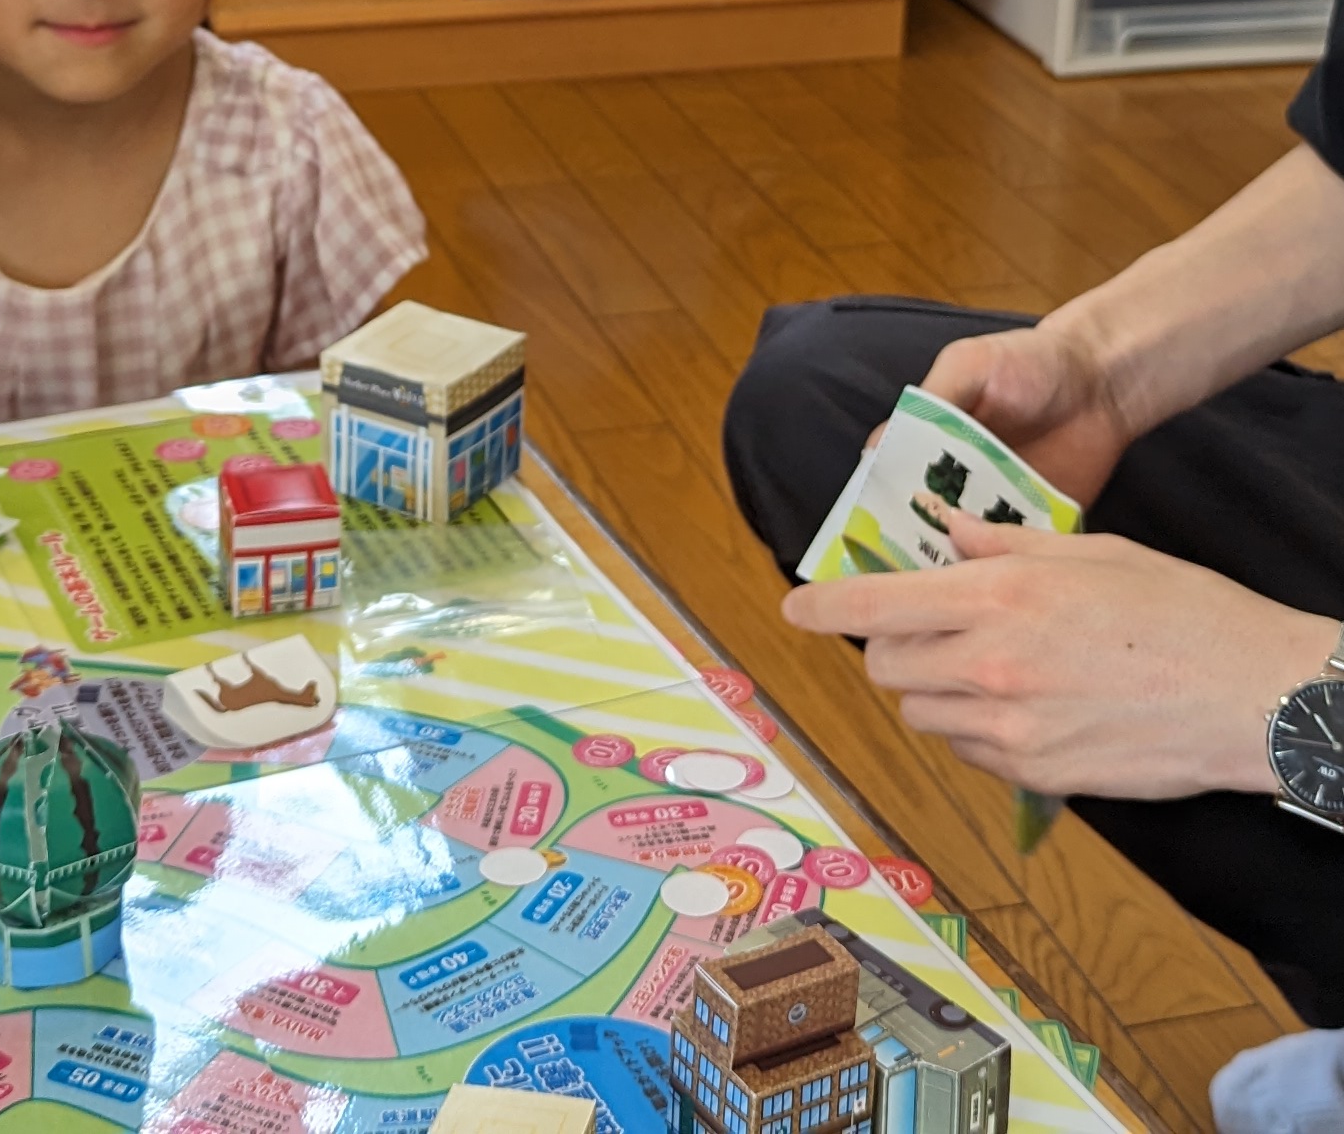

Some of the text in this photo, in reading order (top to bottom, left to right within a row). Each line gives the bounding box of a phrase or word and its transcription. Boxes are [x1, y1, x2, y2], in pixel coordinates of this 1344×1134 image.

[584, 739, 619, 759] 10
[652, 801, 699, 821] +30
[815, 852, 854, 879] 10
[270, 1012, 325, 1041] MAIYA
[59, 1064, 100, 1087] -50
